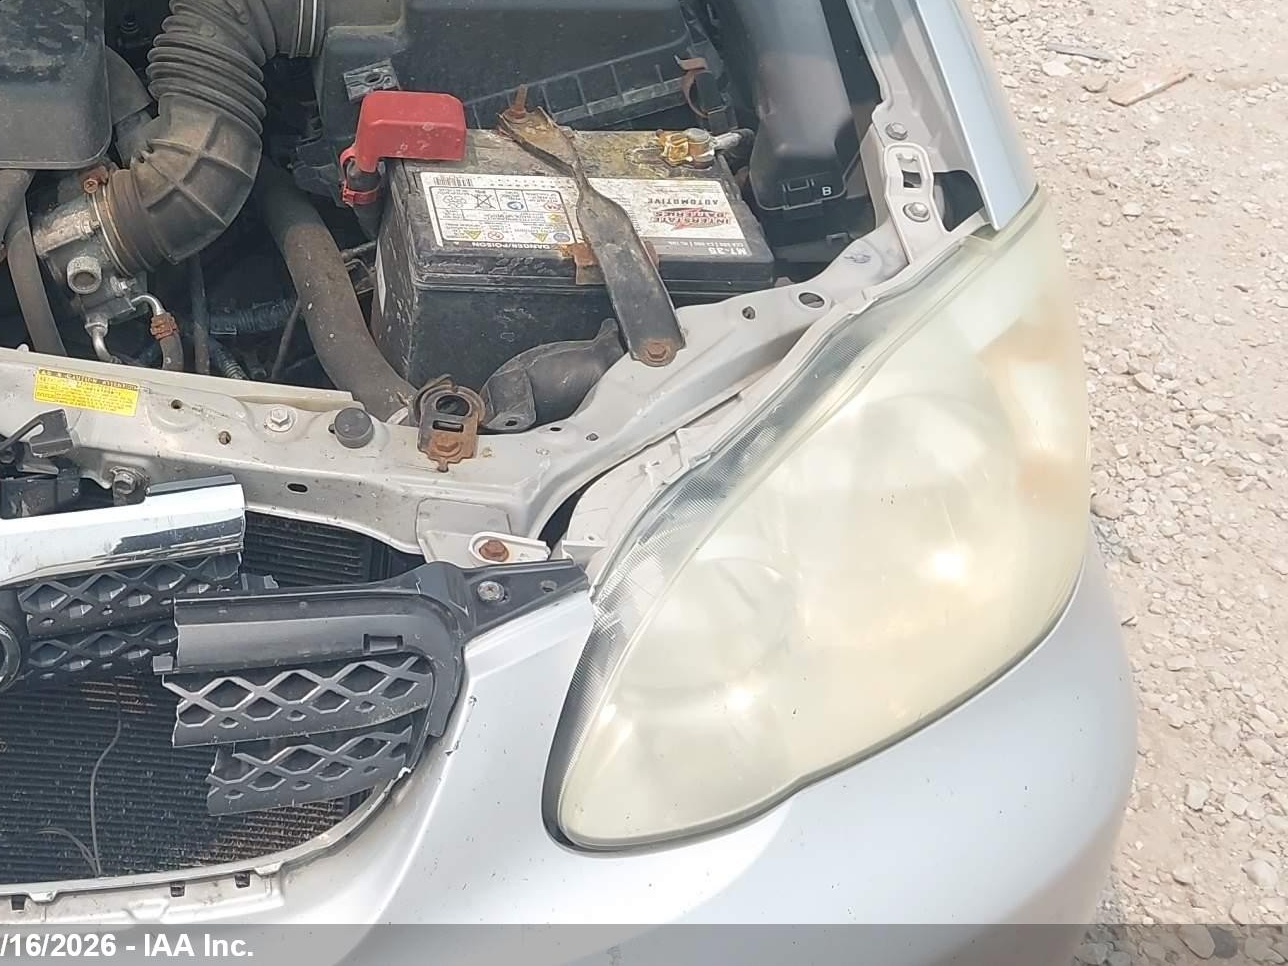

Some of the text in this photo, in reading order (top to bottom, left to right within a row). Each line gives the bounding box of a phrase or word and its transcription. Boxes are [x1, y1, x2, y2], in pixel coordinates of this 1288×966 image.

[821, 186, 833, 197] B
[646, 197, 720, 206] AUTOMOTIVE
[651, 216, 730, 225] INTERSTATE
